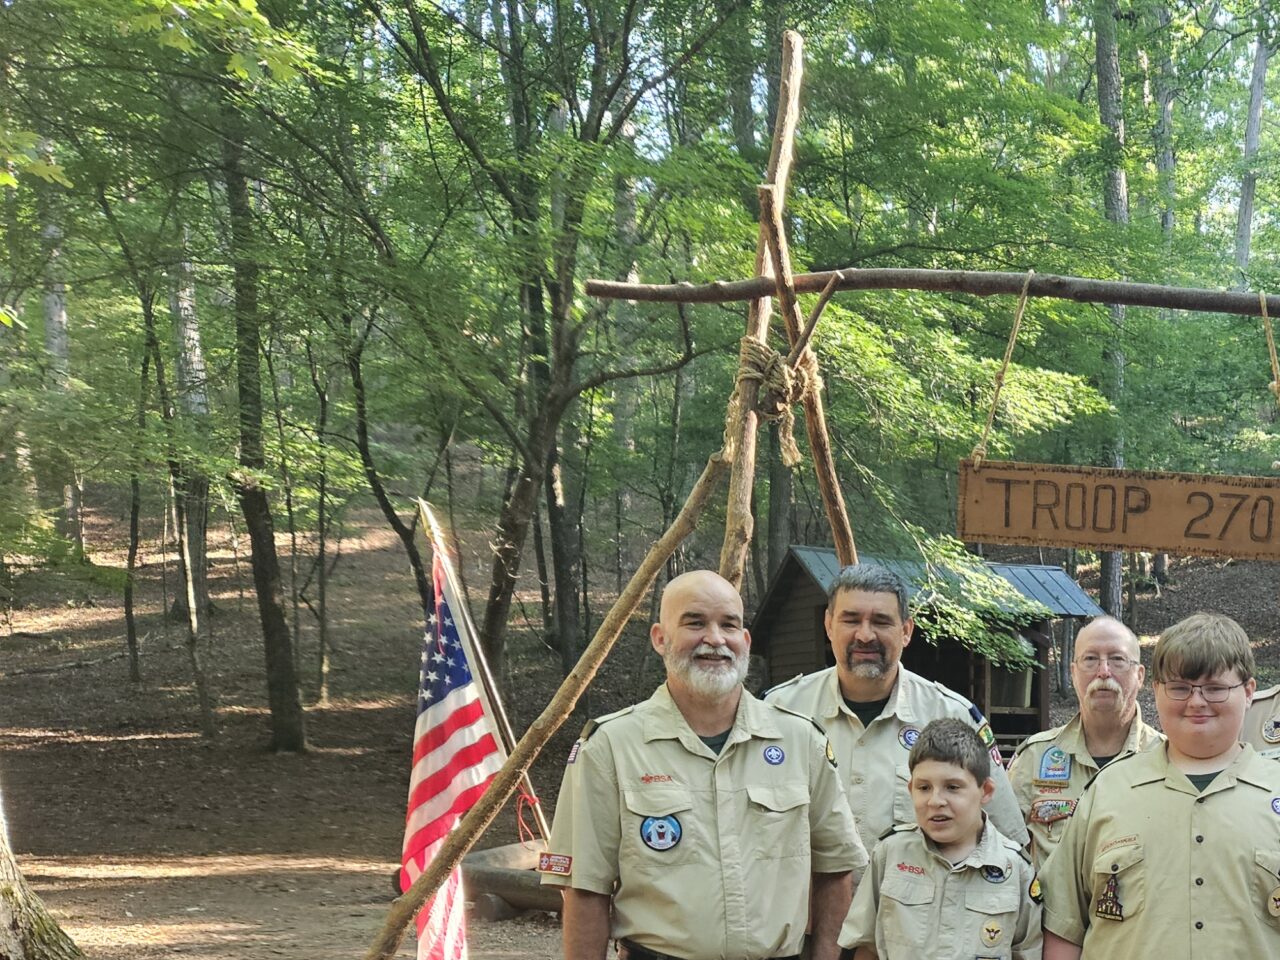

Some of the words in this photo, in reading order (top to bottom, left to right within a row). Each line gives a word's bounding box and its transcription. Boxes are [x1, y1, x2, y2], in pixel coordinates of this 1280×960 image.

[986, 477, 1151, 533] TROOP
[1184, 491, 1275, 543] 270
[653, 775, 672, 783] BSA
[908, 865, 925, 875] BSA
